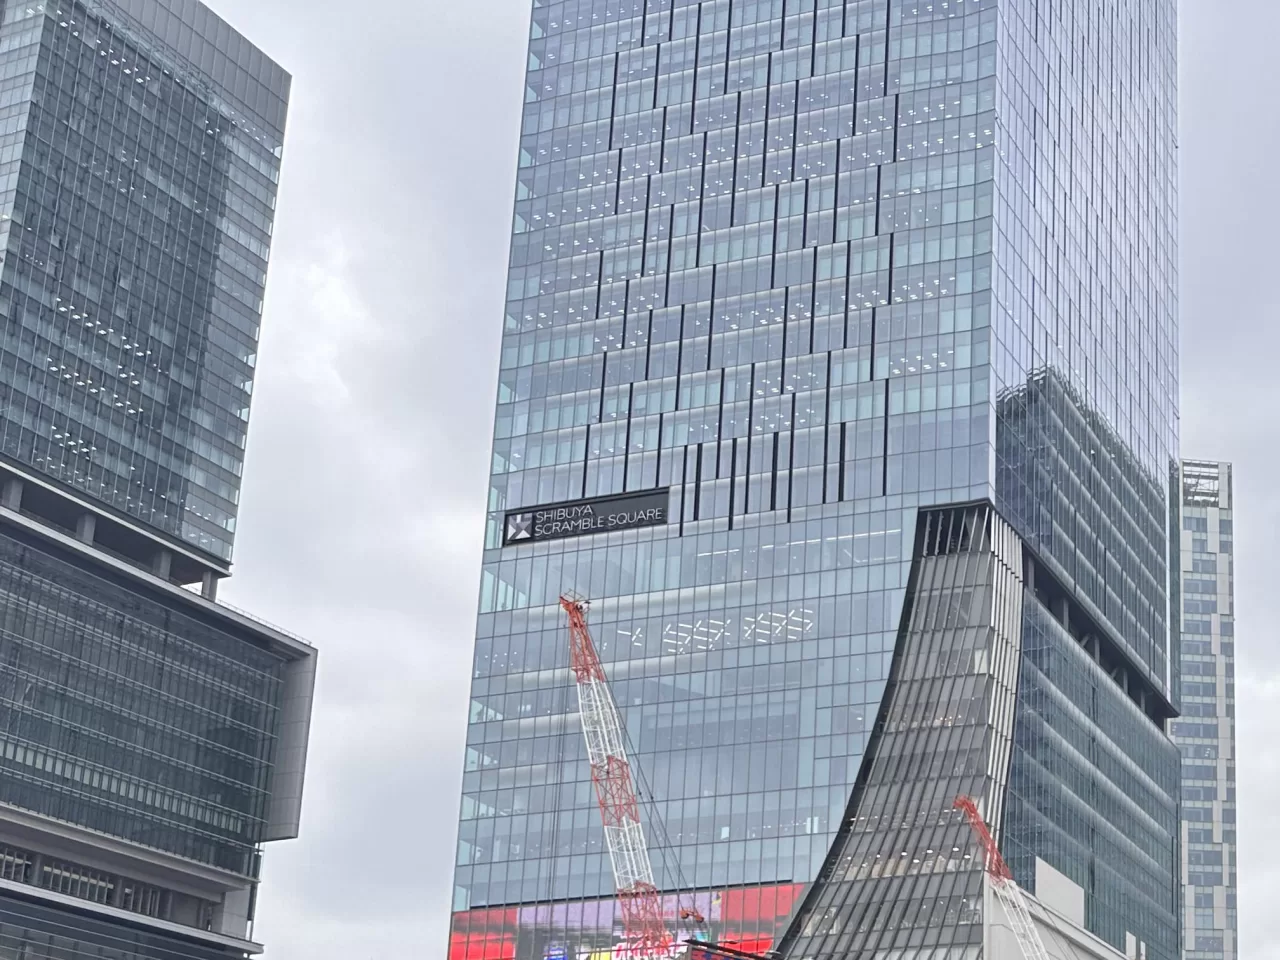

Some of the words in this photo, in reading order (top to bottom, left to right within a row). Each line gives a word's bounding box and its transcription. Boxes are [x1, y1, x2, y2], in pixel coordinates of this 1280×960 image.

[534, 516, 604, 536] SCRAMBLE
[608, 508, 663, 527] SQUARE
[535, 505, 593, 523] SHIBUYA
